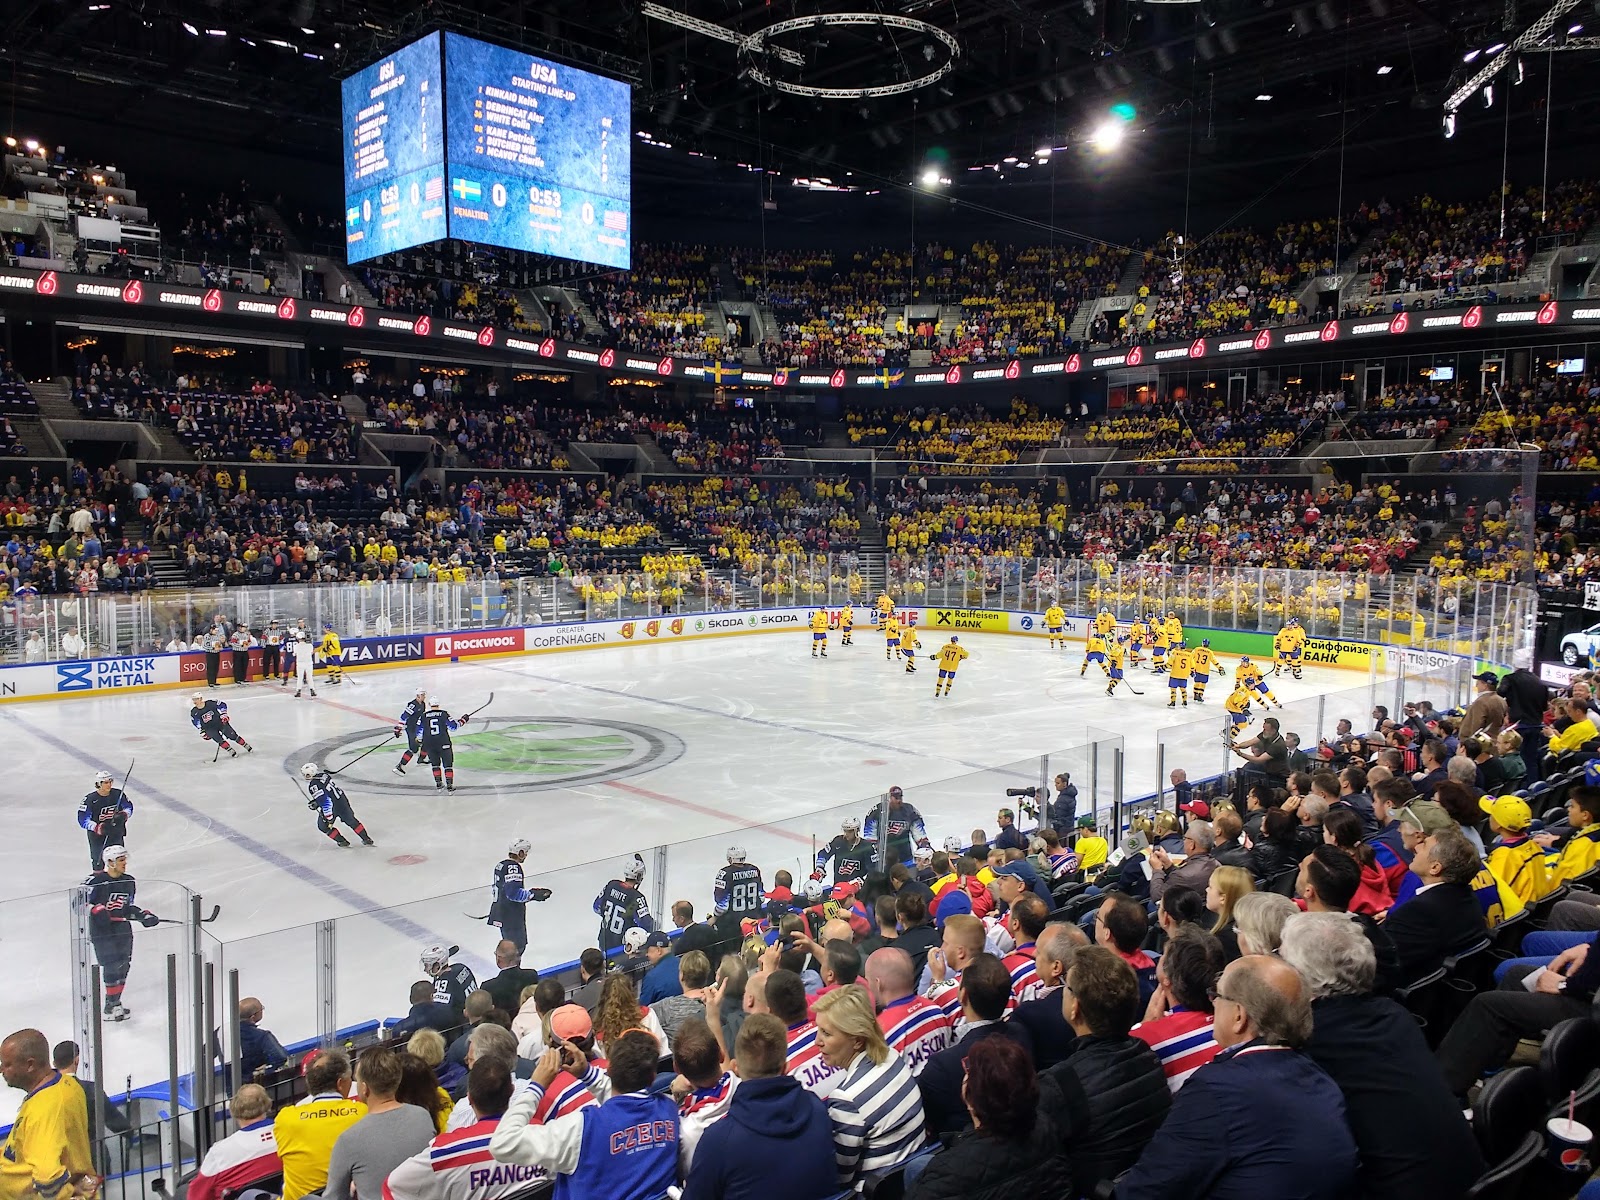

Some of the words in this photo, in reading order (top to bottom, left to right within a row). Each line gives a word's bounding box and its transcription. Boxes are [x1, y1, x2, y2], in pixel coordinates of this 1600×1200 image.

[380, 60, 395, 81] USA
[530, 63, 557, 84] USA
[512, 76, 546, 94] STARTING
[547, 86, 576, 101] LINE-UP
[486, 111, 511, 126] WHITE
[486, 126, 507, 139] KANE
[486, 136, 521, 153] BUTCHER
[410, 182, 420, 206] 0
[492, 183, 507, 207] 0
[529, 186, 561, 208] 0:53
[363, 199, 371, 222] 0
[581, 202, 594, 225] 0
[0, 275, 34, 289] ARTING
[1324, 276, 1343, 288] 309
[76, 283, 120, 298] STARTING
[160, 292, 201, 306] STARTING
[1110, 297, 1127, 307] 308
[238, 301, 277, 315] STARTING
[310, 309, 347, 323] STARTING
[1423, 315, 1462, 328] STARTING
[1496, 310, 1537, 323] STARTING
[378, 317, 414, 331] STARTING
[1352, 322, 1390, 335] STARTING
[443, 327, 477, 341] STARTING
[1284, 330, 1320, 343] STARTING
[506, 338, 539, 352] STARTING
[1218, 340, 1254, 352] STARTING
[567, 349, 599, 363] STARTING
[1093, 355, 1126, 367] STARTING
[1155, 348, 1189, 360] STARTING
[626, 358, 657, 372] STARTING
[1032, 362, 1064, 374] STARTING
[742, 372, 773, 383] STARTING
[799, 375, 830, 385] STARTING
[914, 373, 946, 383] STARTING
[973, 368, 1004, 380] STARTING
[761, 614, 799, 624] ŠKODA
[954, 610, 999, 620] Raiffeisen
[556, 625, 585, 634] GREATER
[708, 618, 744, 629] ŠKODA
[954, 619, 982, 629] BANK
[382, 641, 422, 659] MEN
[454, 636, 515, 650] ROCKWOOL
[944, 650, 957, 662] 47
[1303, 651, 1339, 664] БАНК
[97, 658, 155, 674] DANSK
[183, 662, 207, 673] SPO
[222, 658, 256, 670] EVT
[1180, 658, 1187, 670] 5
[97, 672, 154, 689] METAL
[0, 681, 16, 696] N
[430, 718, 440, 736] 5
[507, 865, 519, 874] 25
[732, 870, 759, 881] ATKINSON
[610, 888, 628, 903] WHITE
[732, 882, 758, 912] 89
[907, 1033, 946, 1069] JAŠKIN
[802, 1055, 844, 1087] JAŠK
[610, 1119, 676, 1156] CZECH
